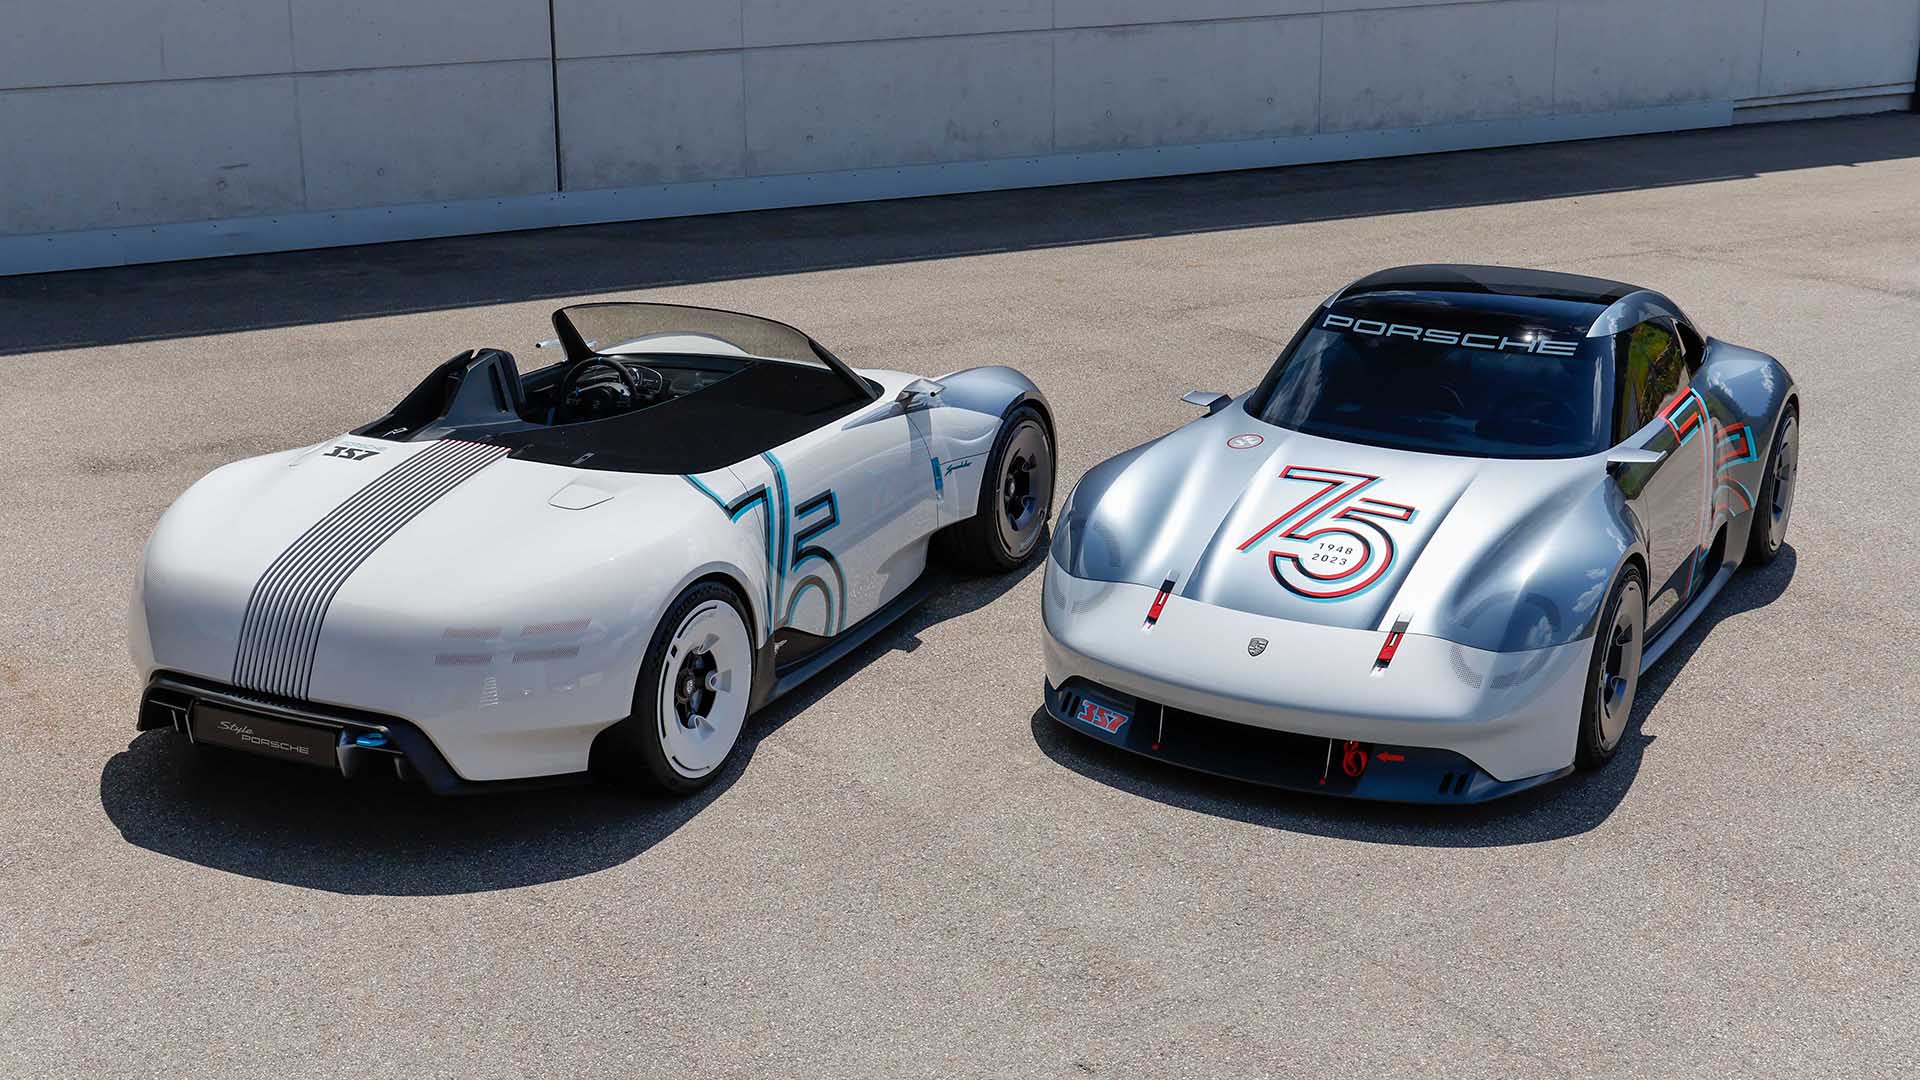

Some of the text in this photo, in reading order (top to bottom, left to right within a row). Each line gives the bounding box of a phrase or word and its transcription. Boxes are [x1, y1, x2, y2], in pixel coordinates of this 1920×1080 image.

[1323, 314, 1579, 356] PORSCHE
[323, 446, 380, 461] 357
[1236, 465, 1420, 603] 75
[1319, 542, 1353, 554] 1948
[1311, 553, 1348, 566] 2023
[1077, 700, 1129, 734] 357
[217, 721, 254, 735] Style
[241, 734, 310, 755] PORSCHE
